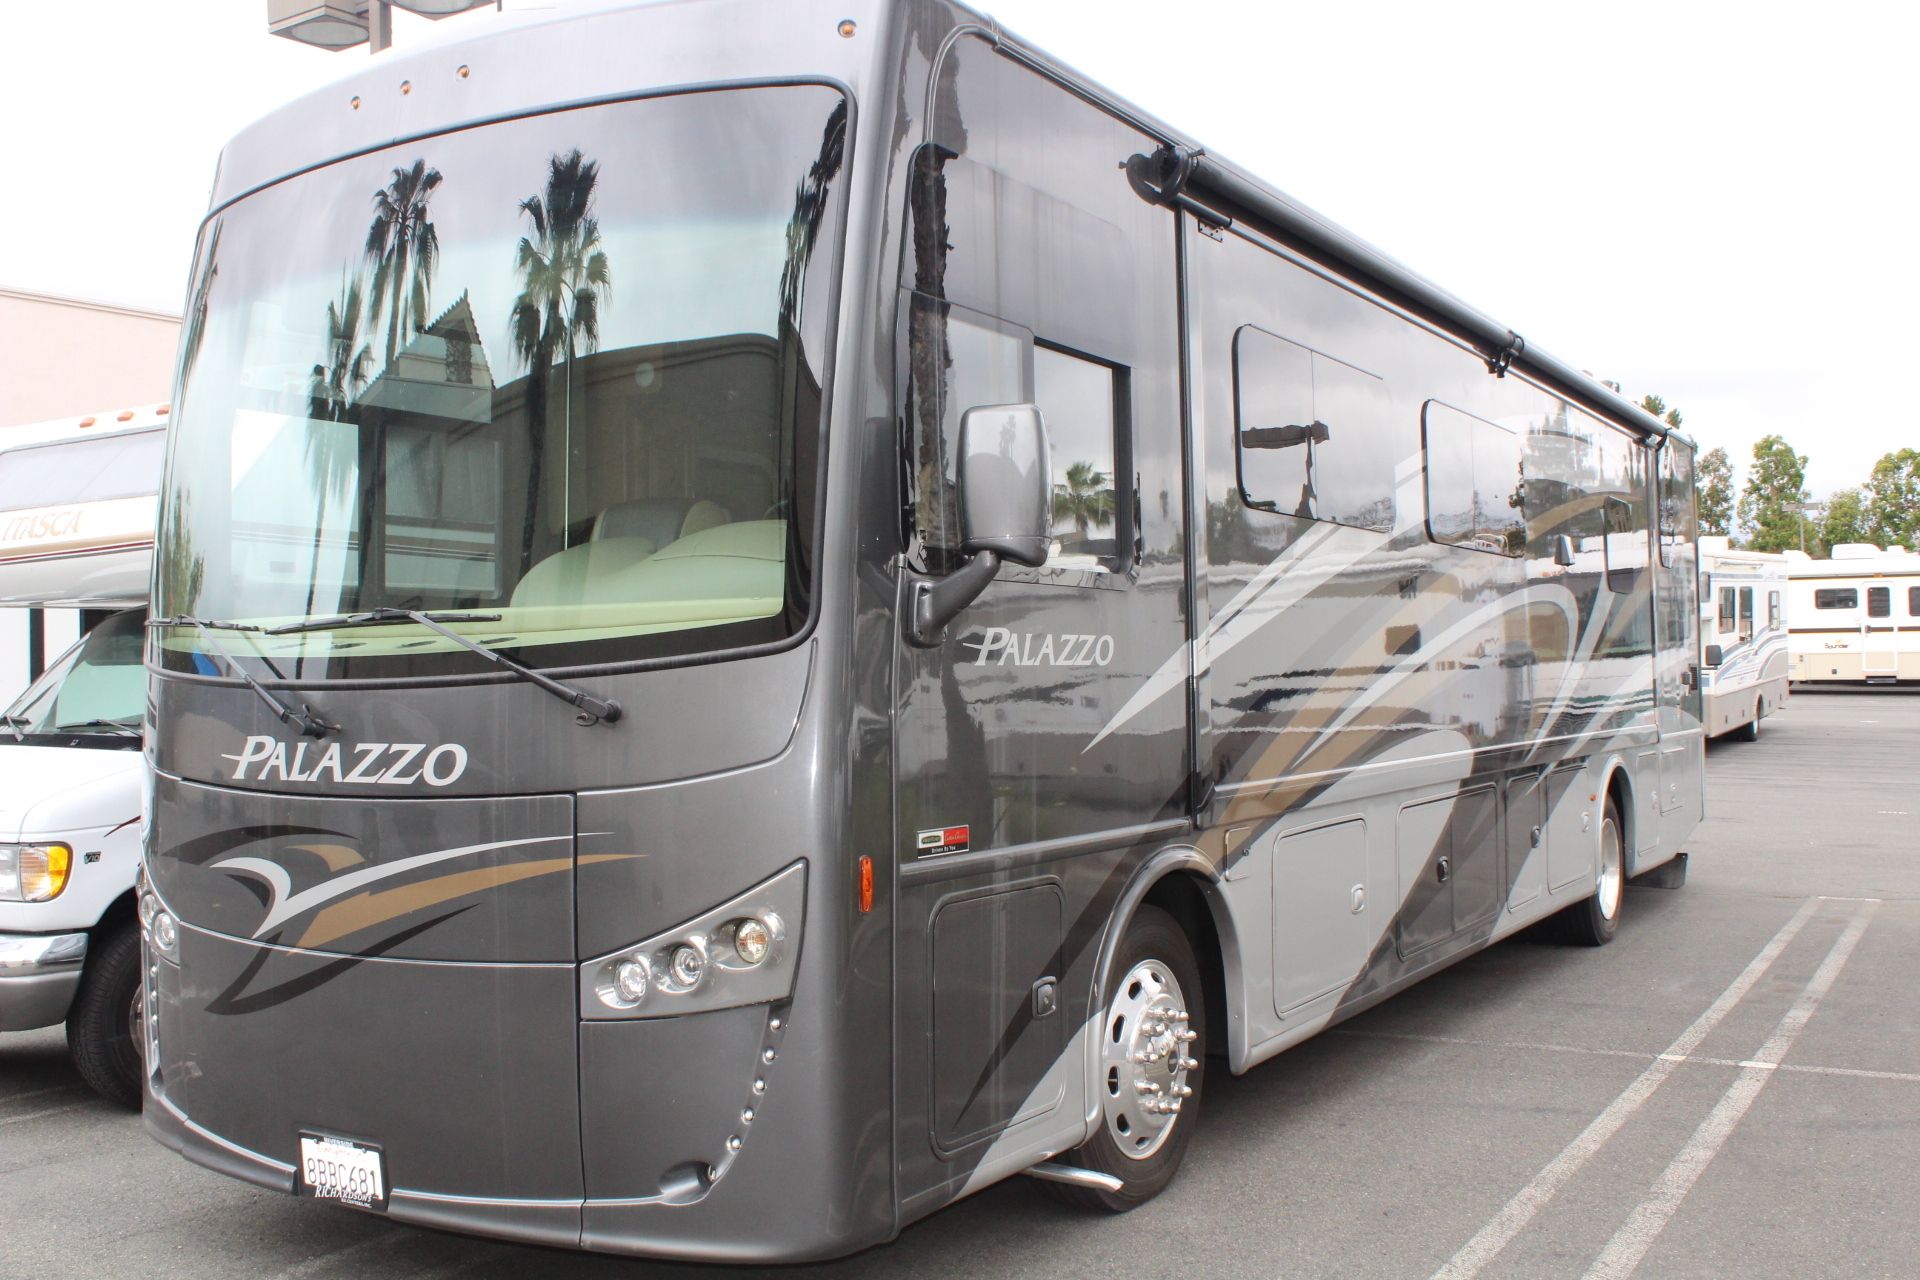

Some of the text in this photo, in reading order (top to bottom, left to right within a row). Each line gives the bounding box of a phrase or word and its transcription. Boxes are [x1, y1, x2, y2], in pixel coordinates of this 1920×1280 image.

[2, 510, 83, 541] ITASCA
[963, 627, 1114, 666] PALAZZO
[221, 736, 467, 786] PALAZZO
[84, 855, 100, 864] V10
[307, 1158, 379, 1196] 8BBC681
